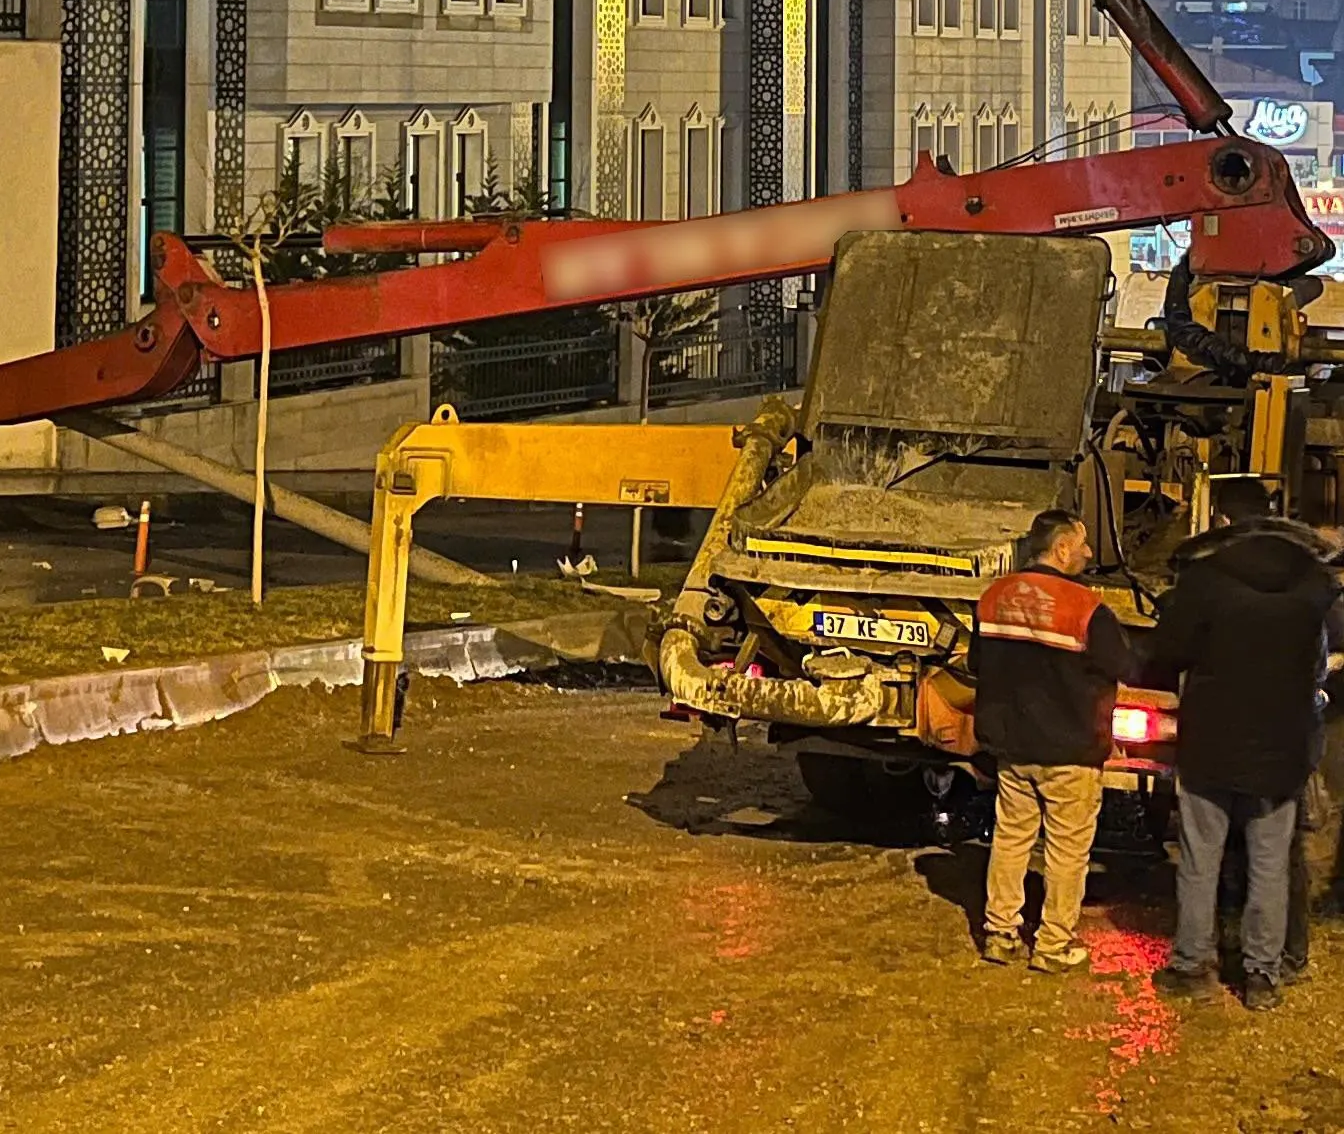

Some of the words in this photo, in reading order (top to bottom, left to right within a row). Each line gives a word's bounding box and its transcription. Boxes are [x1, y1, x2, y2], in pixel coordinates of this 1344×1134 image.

[825, 616, 845, 634] 37
[857, 619, 878, 638] KE
[896, 623, 926, 643] 739
